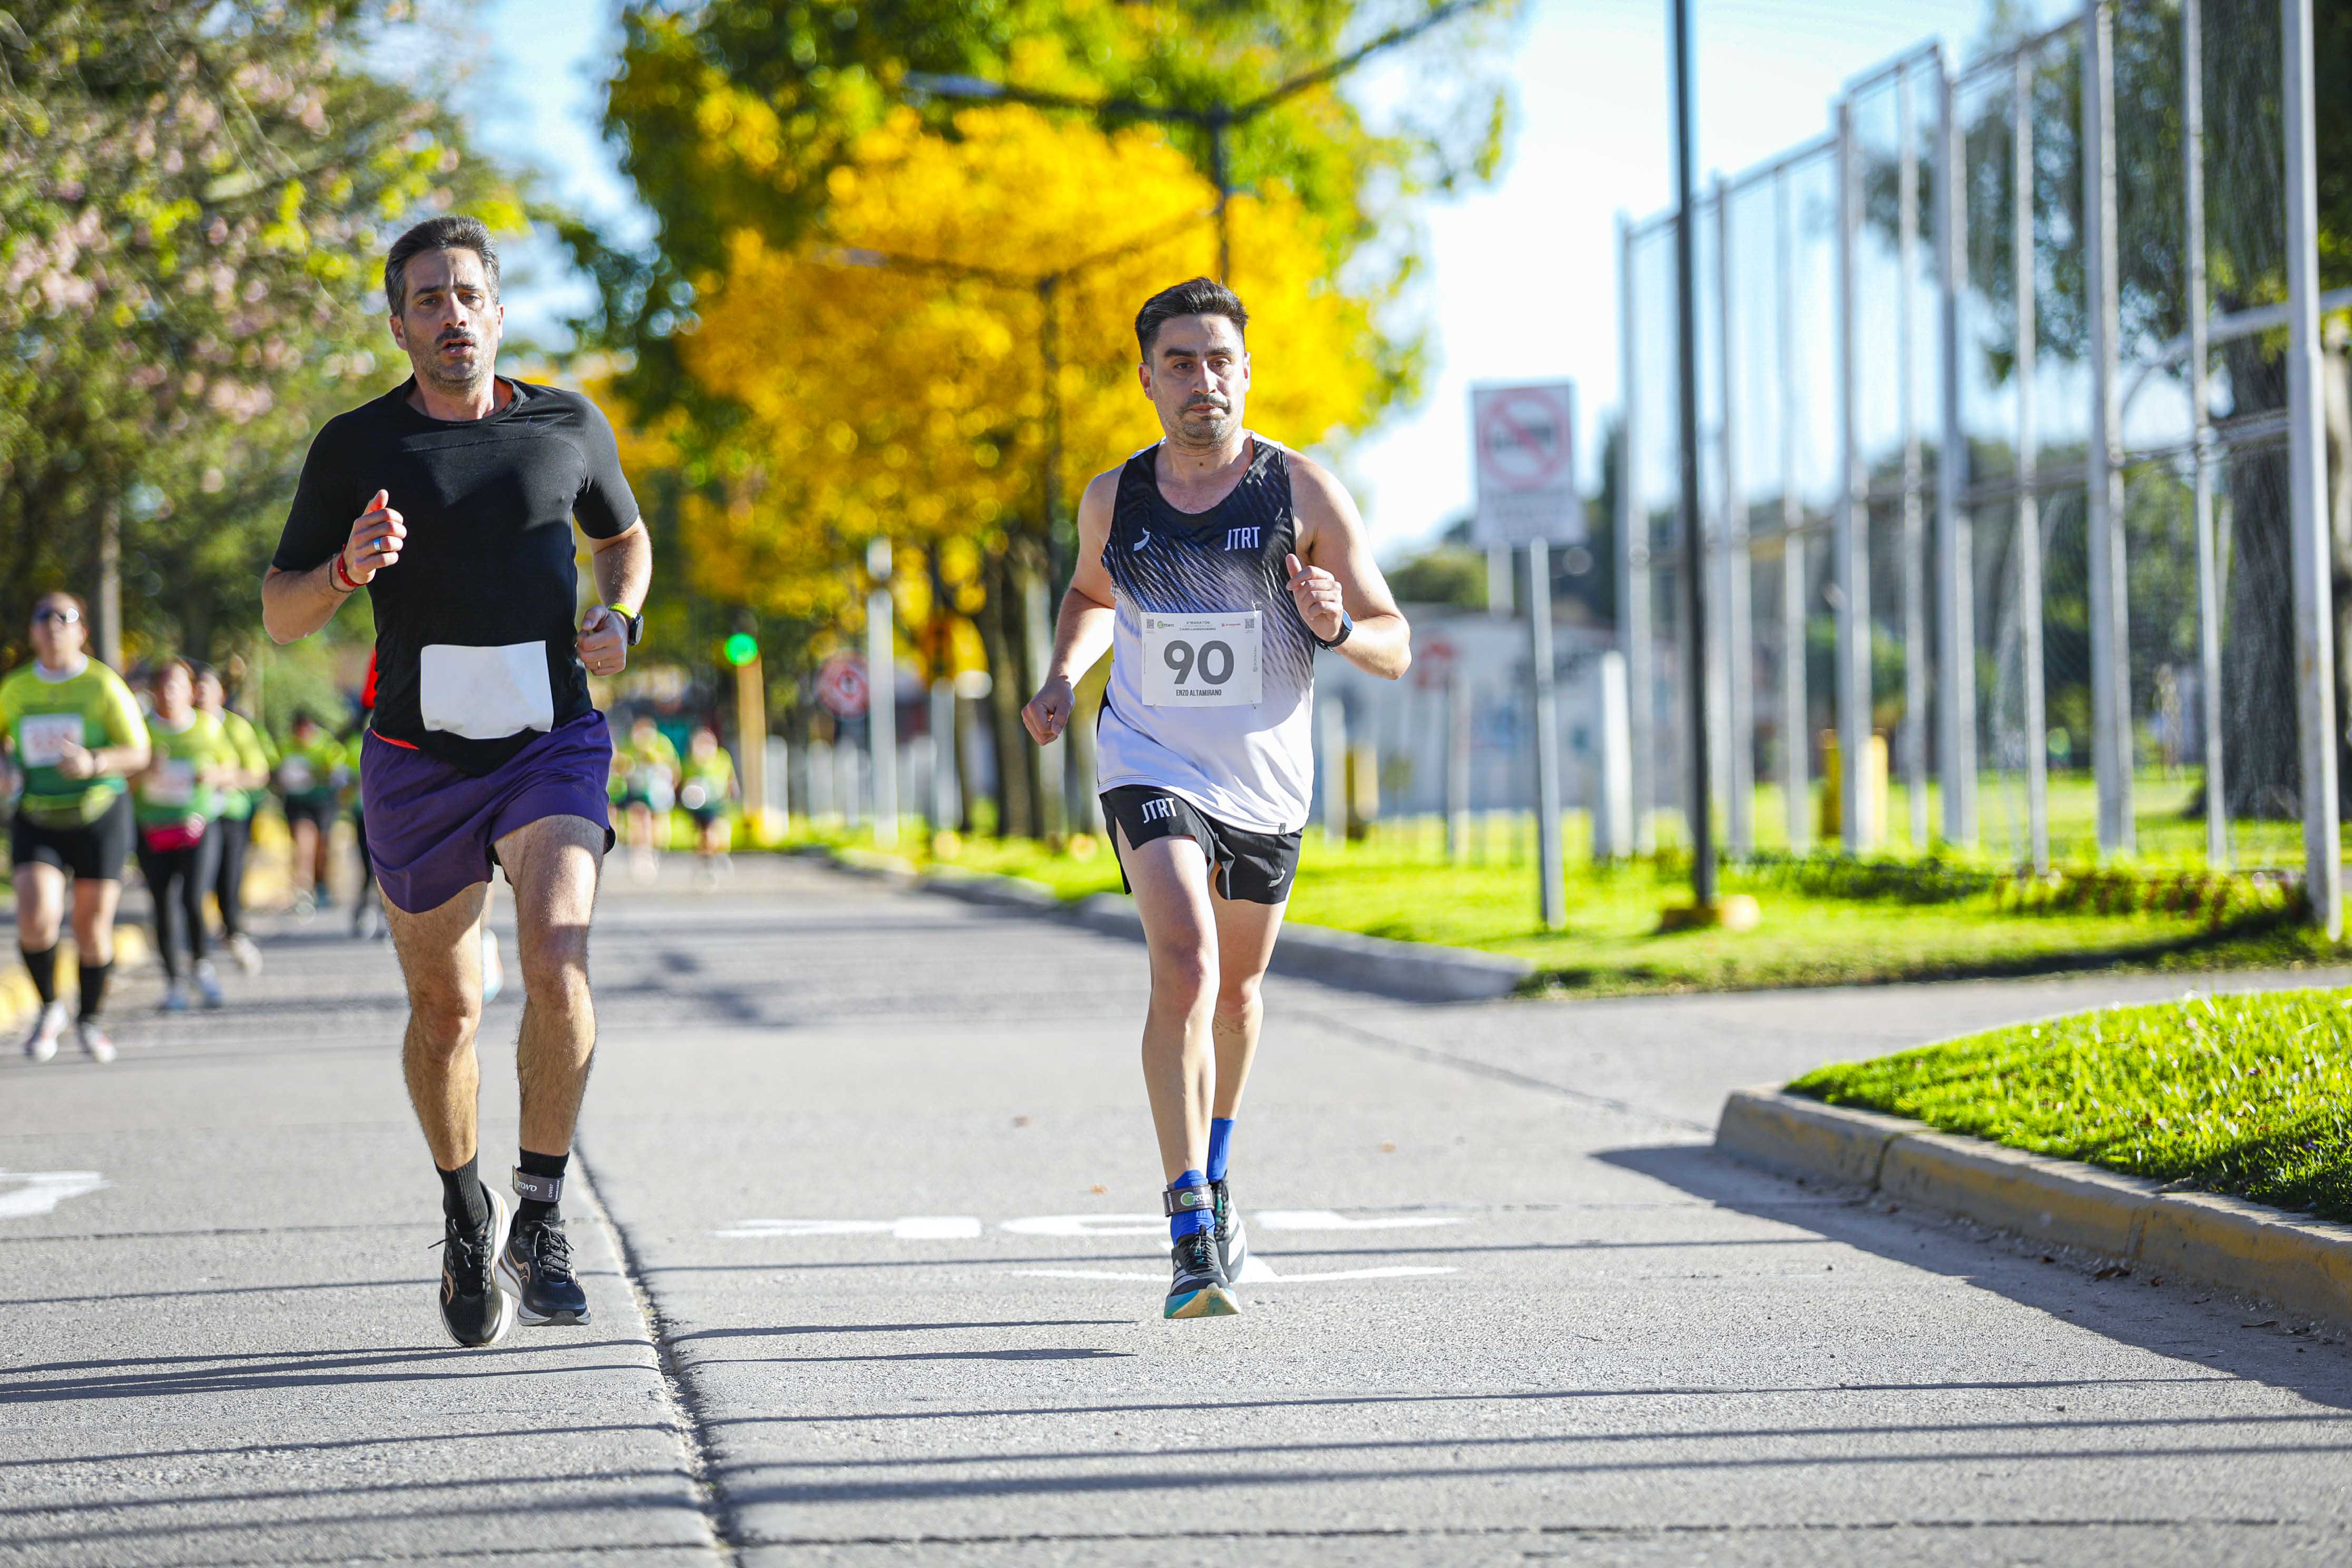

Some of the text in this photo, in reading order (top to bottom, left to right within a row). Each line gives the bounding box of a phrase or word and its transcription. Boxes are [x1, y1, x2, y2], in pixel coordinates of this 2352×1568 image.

[1224, 526, 1260, 551] JTRT
[1164, 640, 1234, 685] 90
[1141, 798, 1177, 824] JTRT
